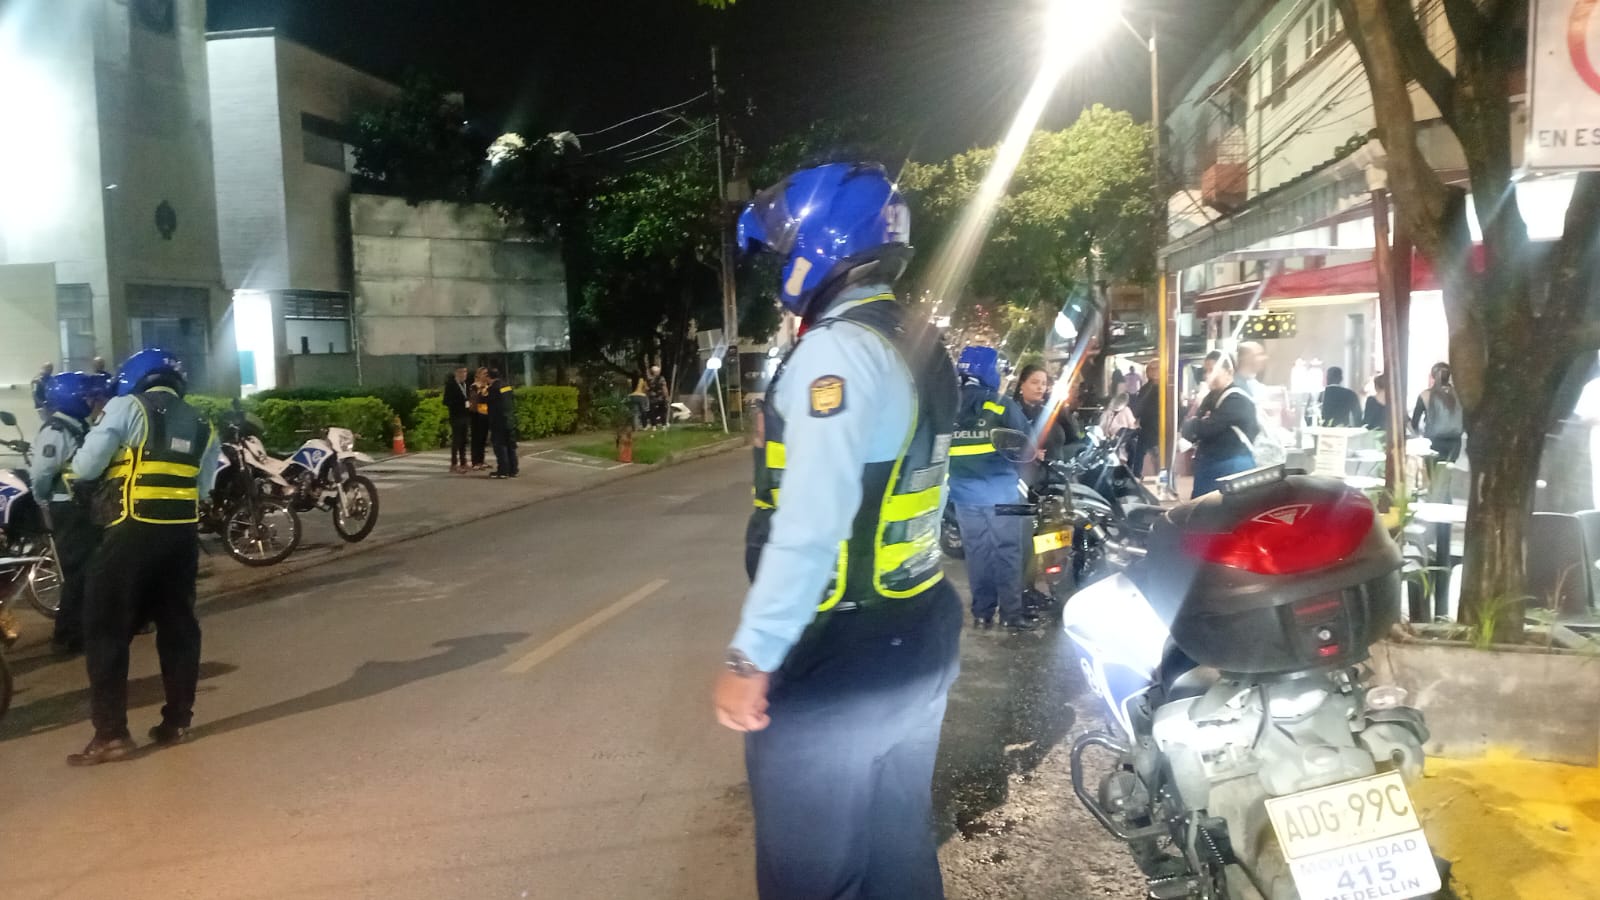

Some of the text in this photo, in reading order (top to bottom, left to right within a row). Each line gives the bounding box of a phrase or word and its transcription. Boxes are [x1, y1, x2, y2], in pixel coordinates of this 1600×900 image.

[1539, 129, 1567, 148] EN
[1284, 784, 1409, 843] ADG 99C
[1300, 838, 1418, 876] MOVILIDAD
[1337, 860, 1397, 890] 415
